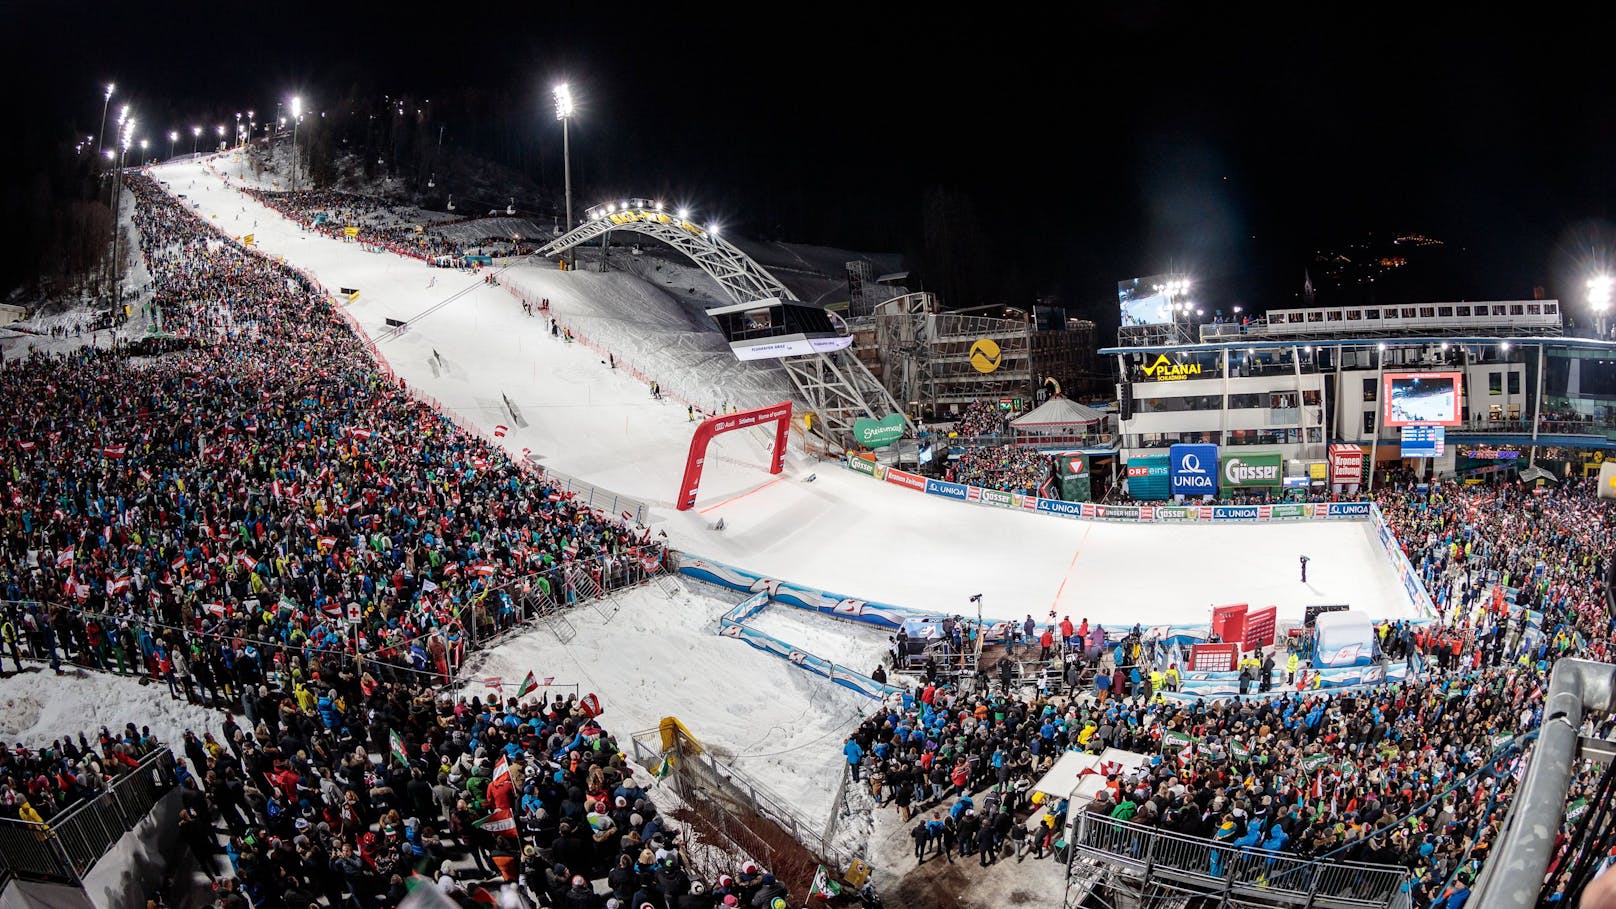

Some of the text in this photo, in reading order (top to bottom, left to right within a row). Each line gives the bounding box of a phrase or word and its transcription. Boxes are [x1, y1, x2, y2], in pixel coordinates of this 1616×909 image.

[1157, 364, 1201, 375] PLANAI
[1335, 456, 1360, 465] Kronen
[1149, 467, 1168, 475] eins
[1225, 458, 1278, 484] Gösser
[1335, 466, 1360, 477] Zeitung
[1173, 476, 1213, 487] UNIQA
[940, 486, 965, 496] UNIQA
[982, 489, 1010, 503] Gösser
[1051, 504, 1080, 514] UNIQA
[1156, 507, 1185, 519] Gösser
[1343, 506, 1369, 514] UNIQA
